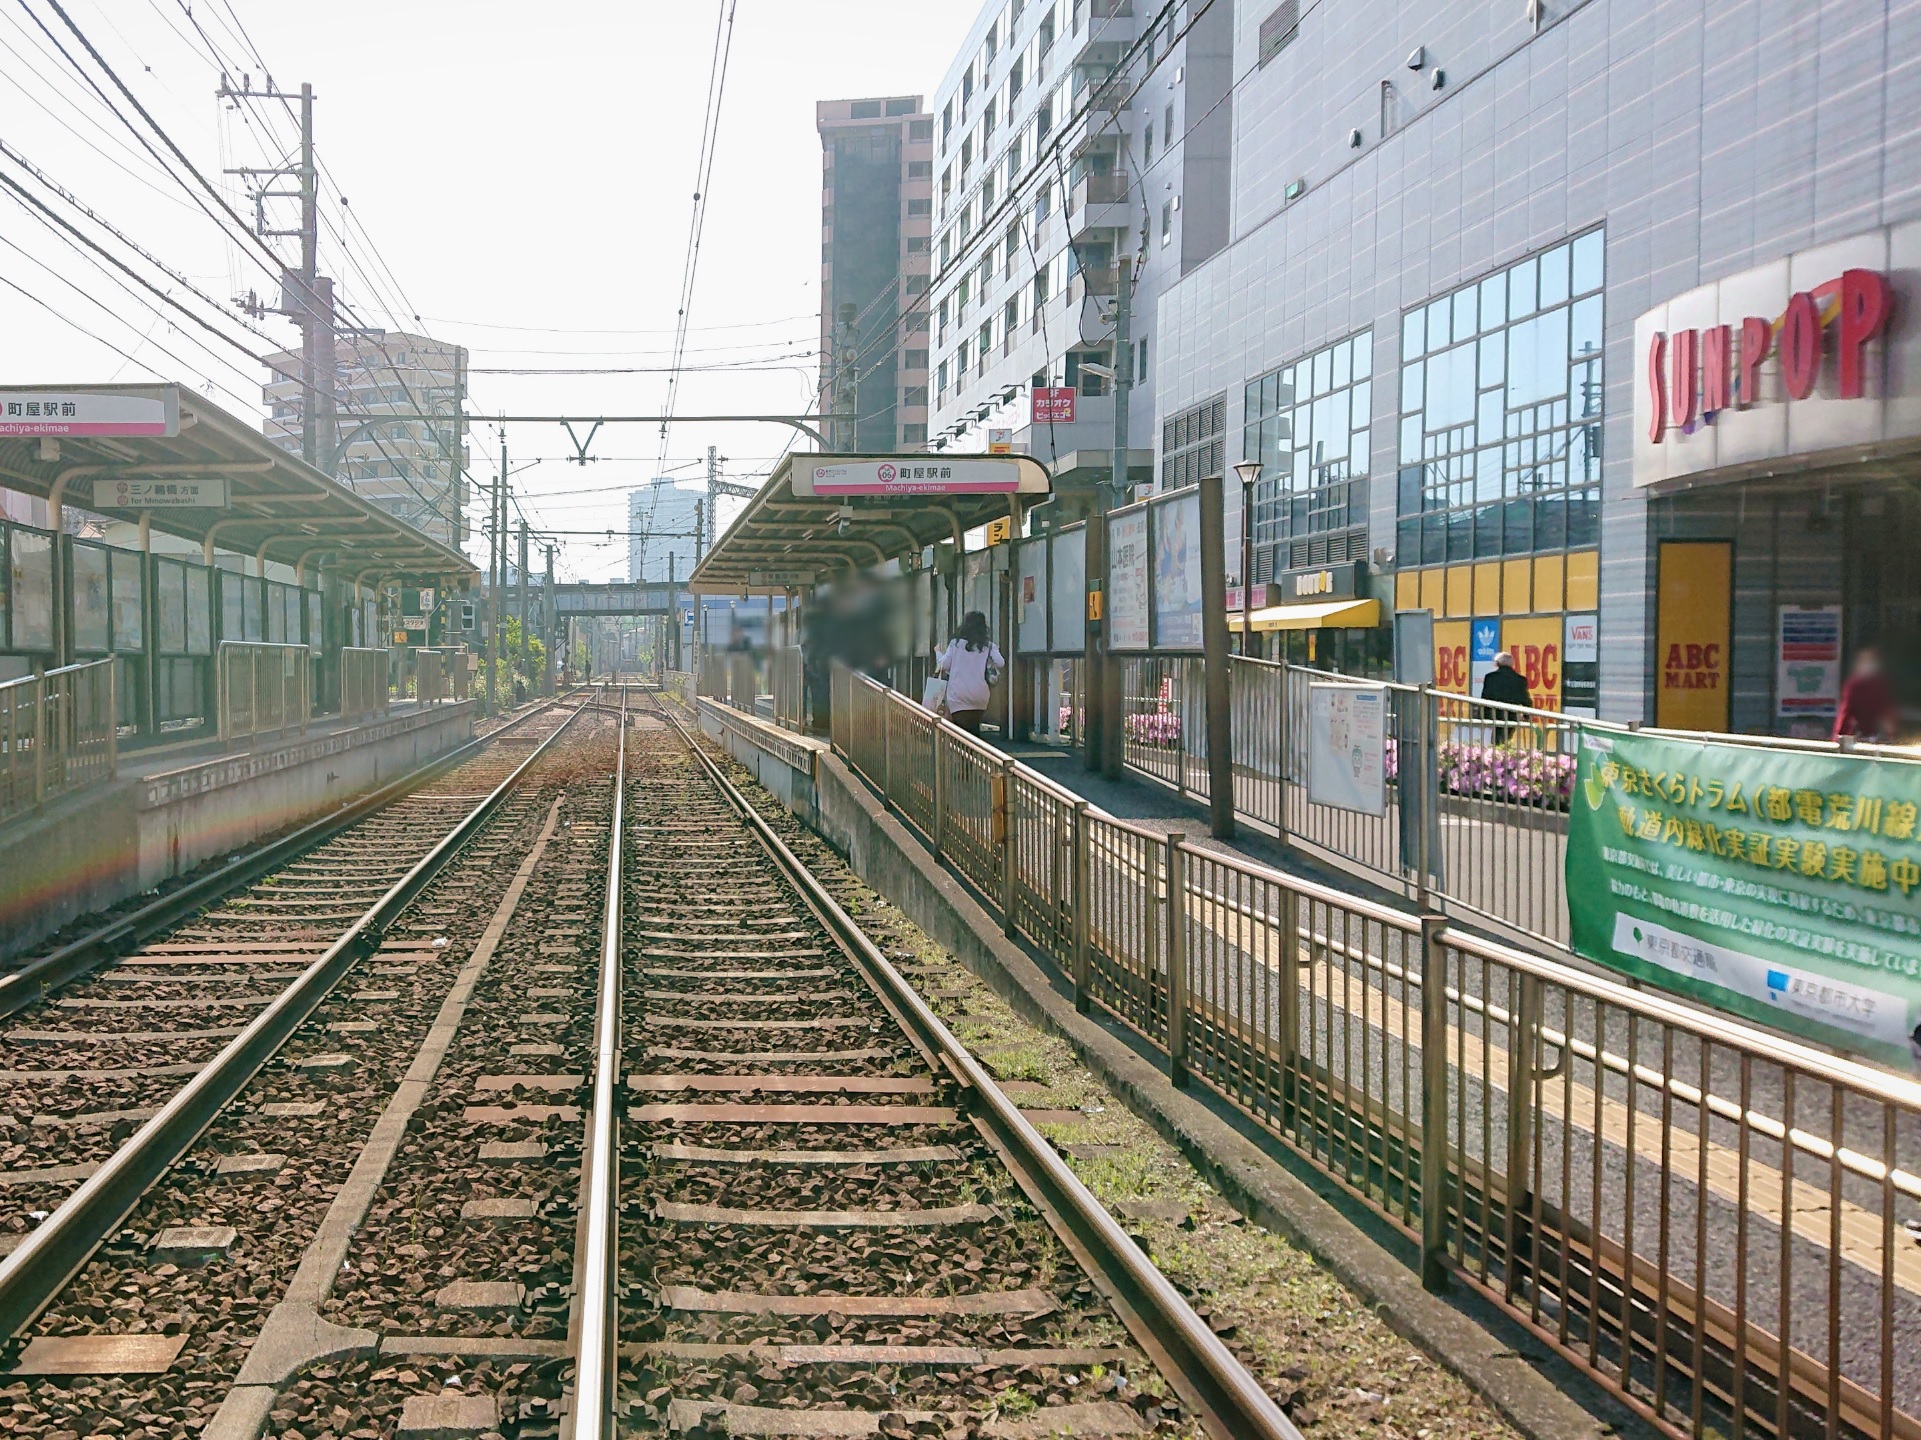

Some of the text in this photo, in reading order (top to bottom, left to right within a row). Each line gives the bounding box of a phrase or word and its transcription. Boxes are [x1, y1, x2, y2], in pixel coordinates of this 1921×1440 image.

[1648, 268, 1890, 444] SUNPOP
[8, 402, 76, 417] 町屋駅前
[900, 467, 952, 479] 町屋駅前
[131, 484, 178, 495] 三ノ輪橋
[180, 485, 199, 495] 方面
[885, 483, 946, 493] Machiya-ekimae
[1571, 625, 1594, 641] VANS
[1665, 644, 1720, 670] ABC
[1435, 645, 1466, 687] BC
[1665, 672, 1720, 689] MART
[1601, 761, 1921, 841] 東京さくらトラム（都電荒川線
[1618, 805, 1920, 895] 軌道内緑化実証実験実施中
